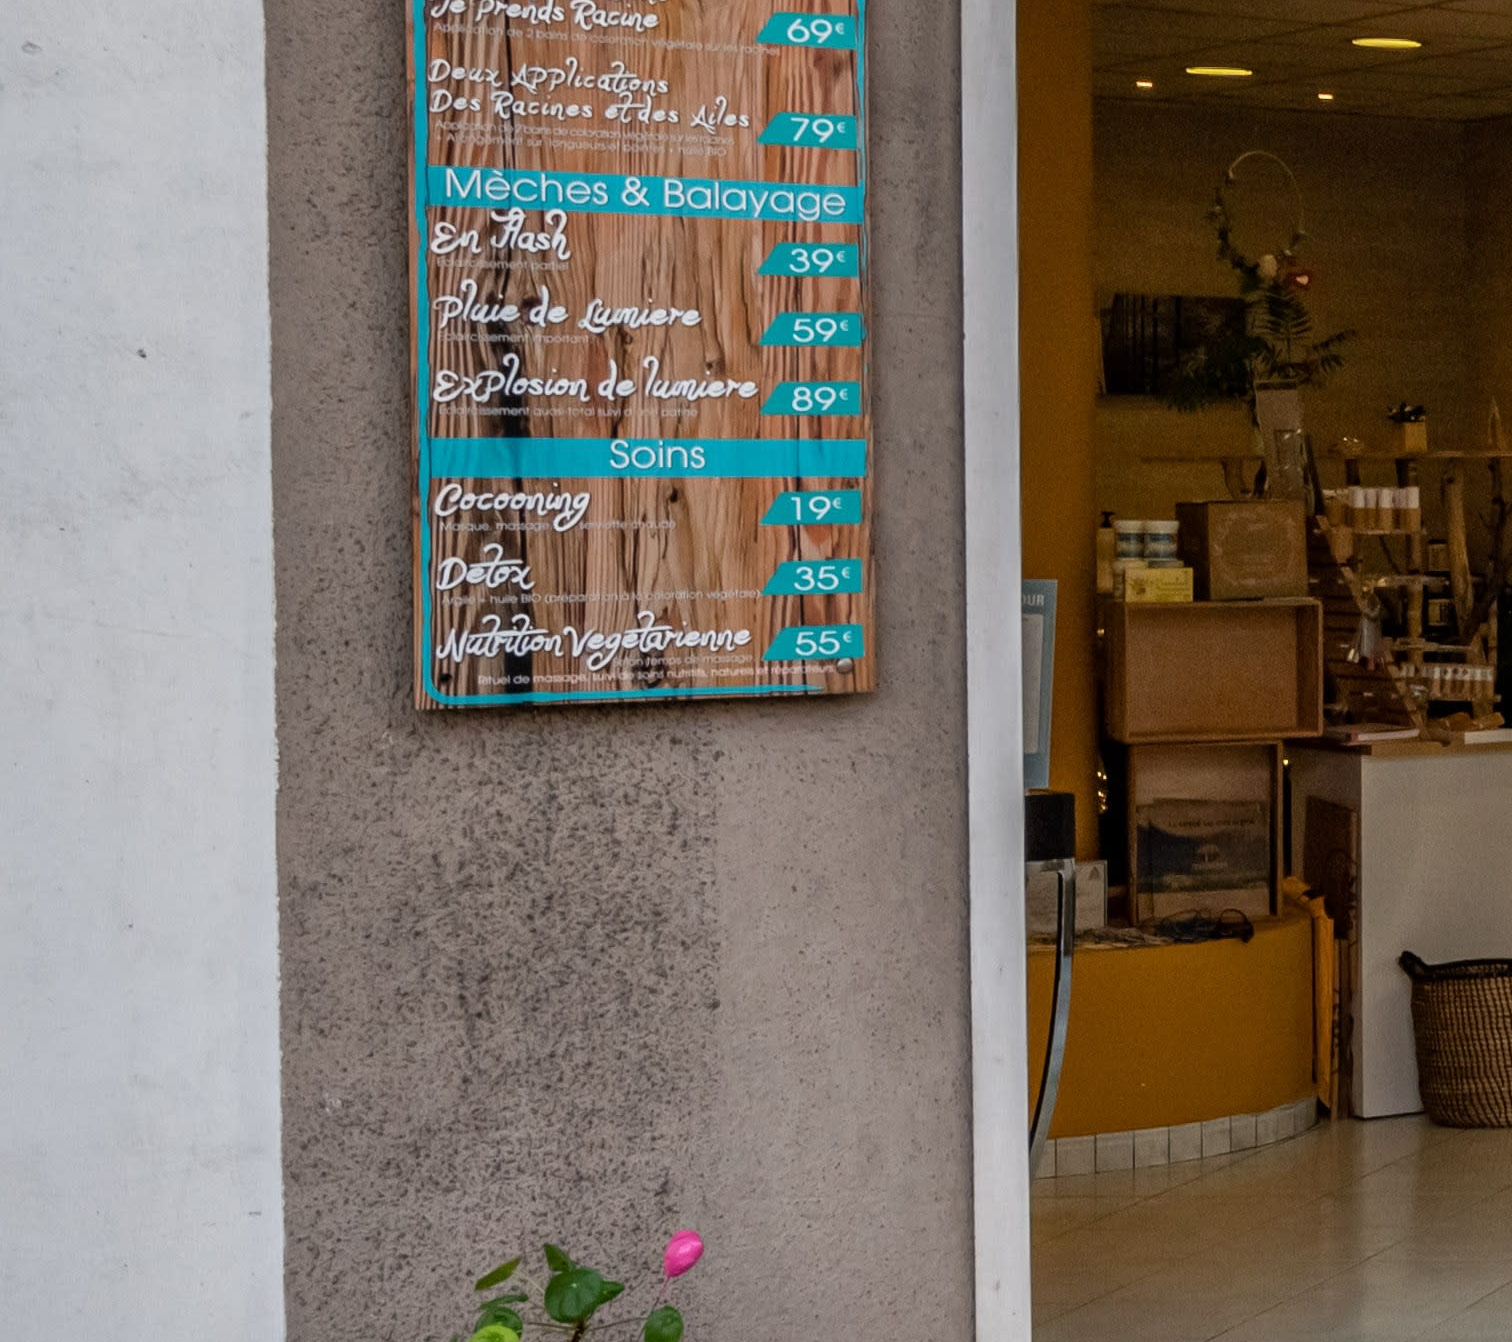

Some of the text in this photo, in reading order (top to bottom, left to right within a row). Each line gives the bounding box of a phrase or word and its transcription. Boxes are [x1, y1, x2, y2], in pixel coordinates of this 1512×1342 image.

[787, 17, 845, 44] 69€
[427, 58, 502, 88] Deux
[429, 89, 480, 113] Des
[490, 91, 592, 120] Racines
[790, 117, 846, 143] 79€
[445, 166, 847, 223] Mèches & Balayage
[431, 222, 481, 254] En
[788, 248, 848, 274] 39€
[433, 279, 702, 333] Pluie de Lumiere
[792, 317, 850, 344] 59€
[598, 360, 637, 401] de
[791, 386, 850, 413] 89€
[609, 439, 707, 470] Soins
[434, 482, 591, 532] Cocooning
[790, 496, 842, 522] 19€
[435, 542, 535, 590] Detox
[794, 565, 851, 592] 35€
[435, 610, 753, 671] Nutrition Vegetarienne
[794, 630, 852, 657] 55€
